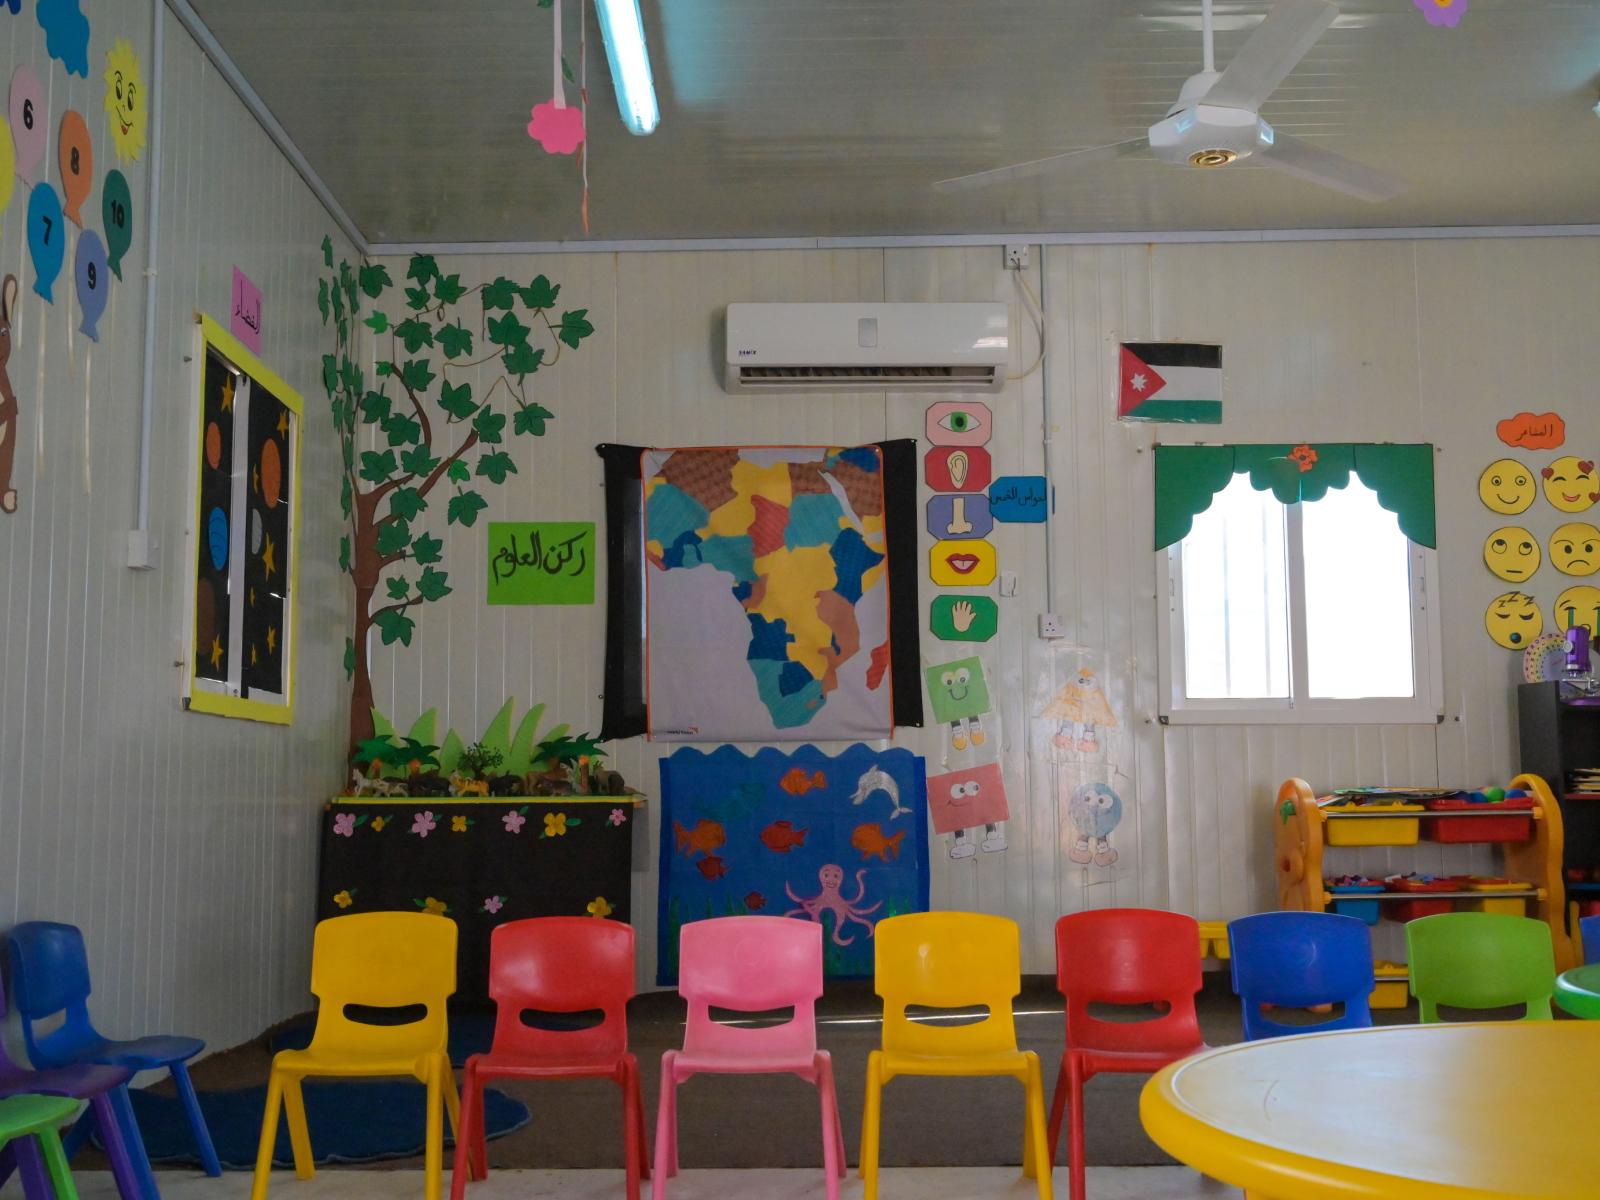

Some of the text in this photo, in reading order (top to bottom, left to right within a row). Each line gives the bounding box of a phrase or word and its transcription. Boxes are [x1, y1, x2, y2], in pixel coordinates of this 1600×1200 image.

[23, 98, 34, 131] 6
[70, 146, 80, 176] 8
[111, 199, 125, 229] 10
[42, 215, 53, 246] 7
[87, 261, 97, 290] 9
[492, 530, 588, 586] ركن العلوم
